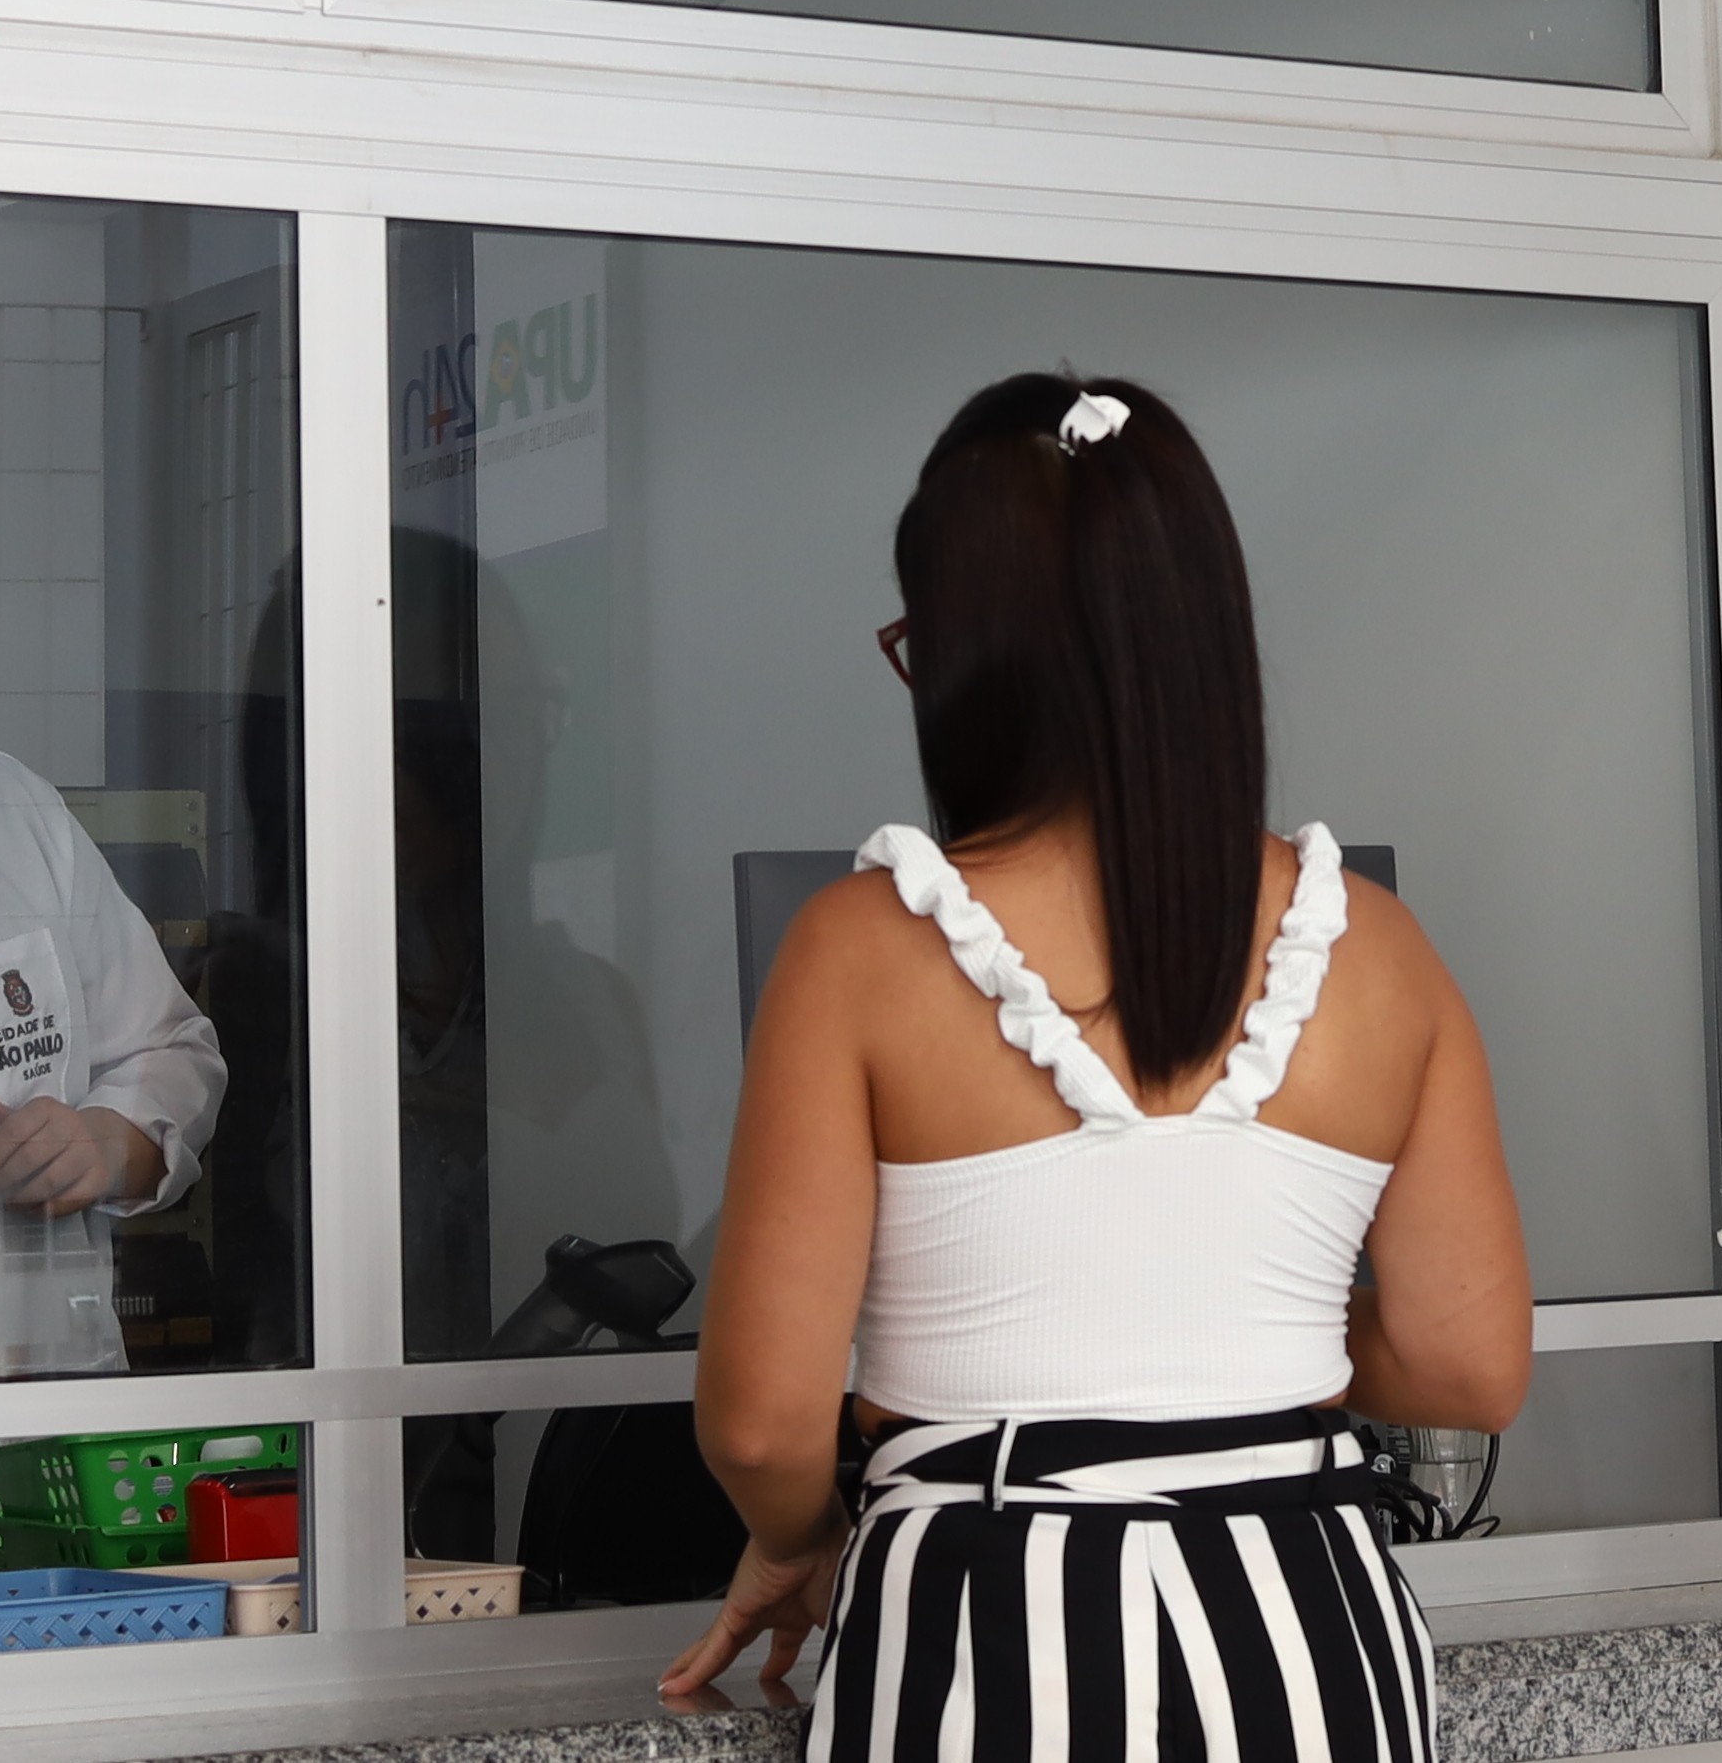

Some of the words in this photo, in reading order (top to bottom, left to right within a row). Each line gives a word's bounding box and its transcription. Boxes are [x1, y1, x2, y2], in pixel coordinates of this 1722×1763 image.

[43, 1014, 55, 1029] DE
[24, 1032, 64, 1062] PAULO
[23, 1062, 52, 1081] SAÚDE
